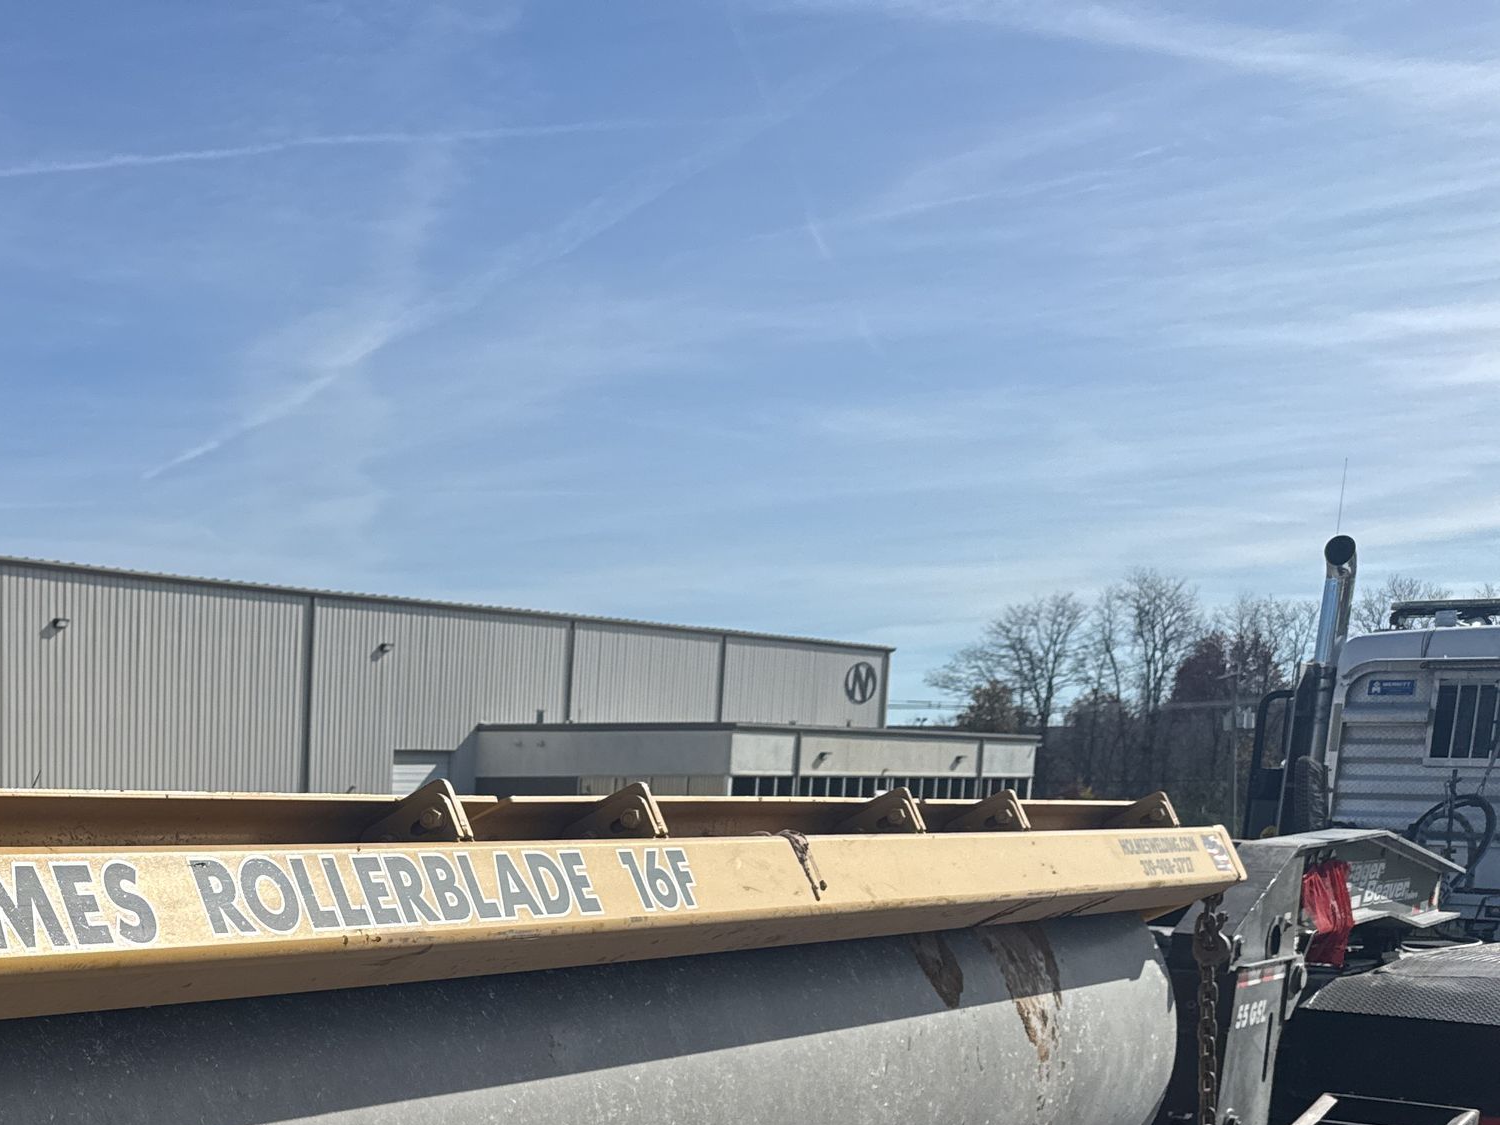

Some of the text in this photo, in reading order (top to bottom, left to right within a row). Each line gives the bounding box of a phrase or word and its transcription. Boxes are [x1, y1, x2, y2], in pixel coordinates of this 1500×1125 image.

[1348, 862, 1386, 887] ager
[187, 848, 604, 937] ROLLERBLADE
[616, 847, 699, 912] 16F
[1363, 880, 1411, 904] Beaver
[1235, 1003, 1250, 1029] 55
